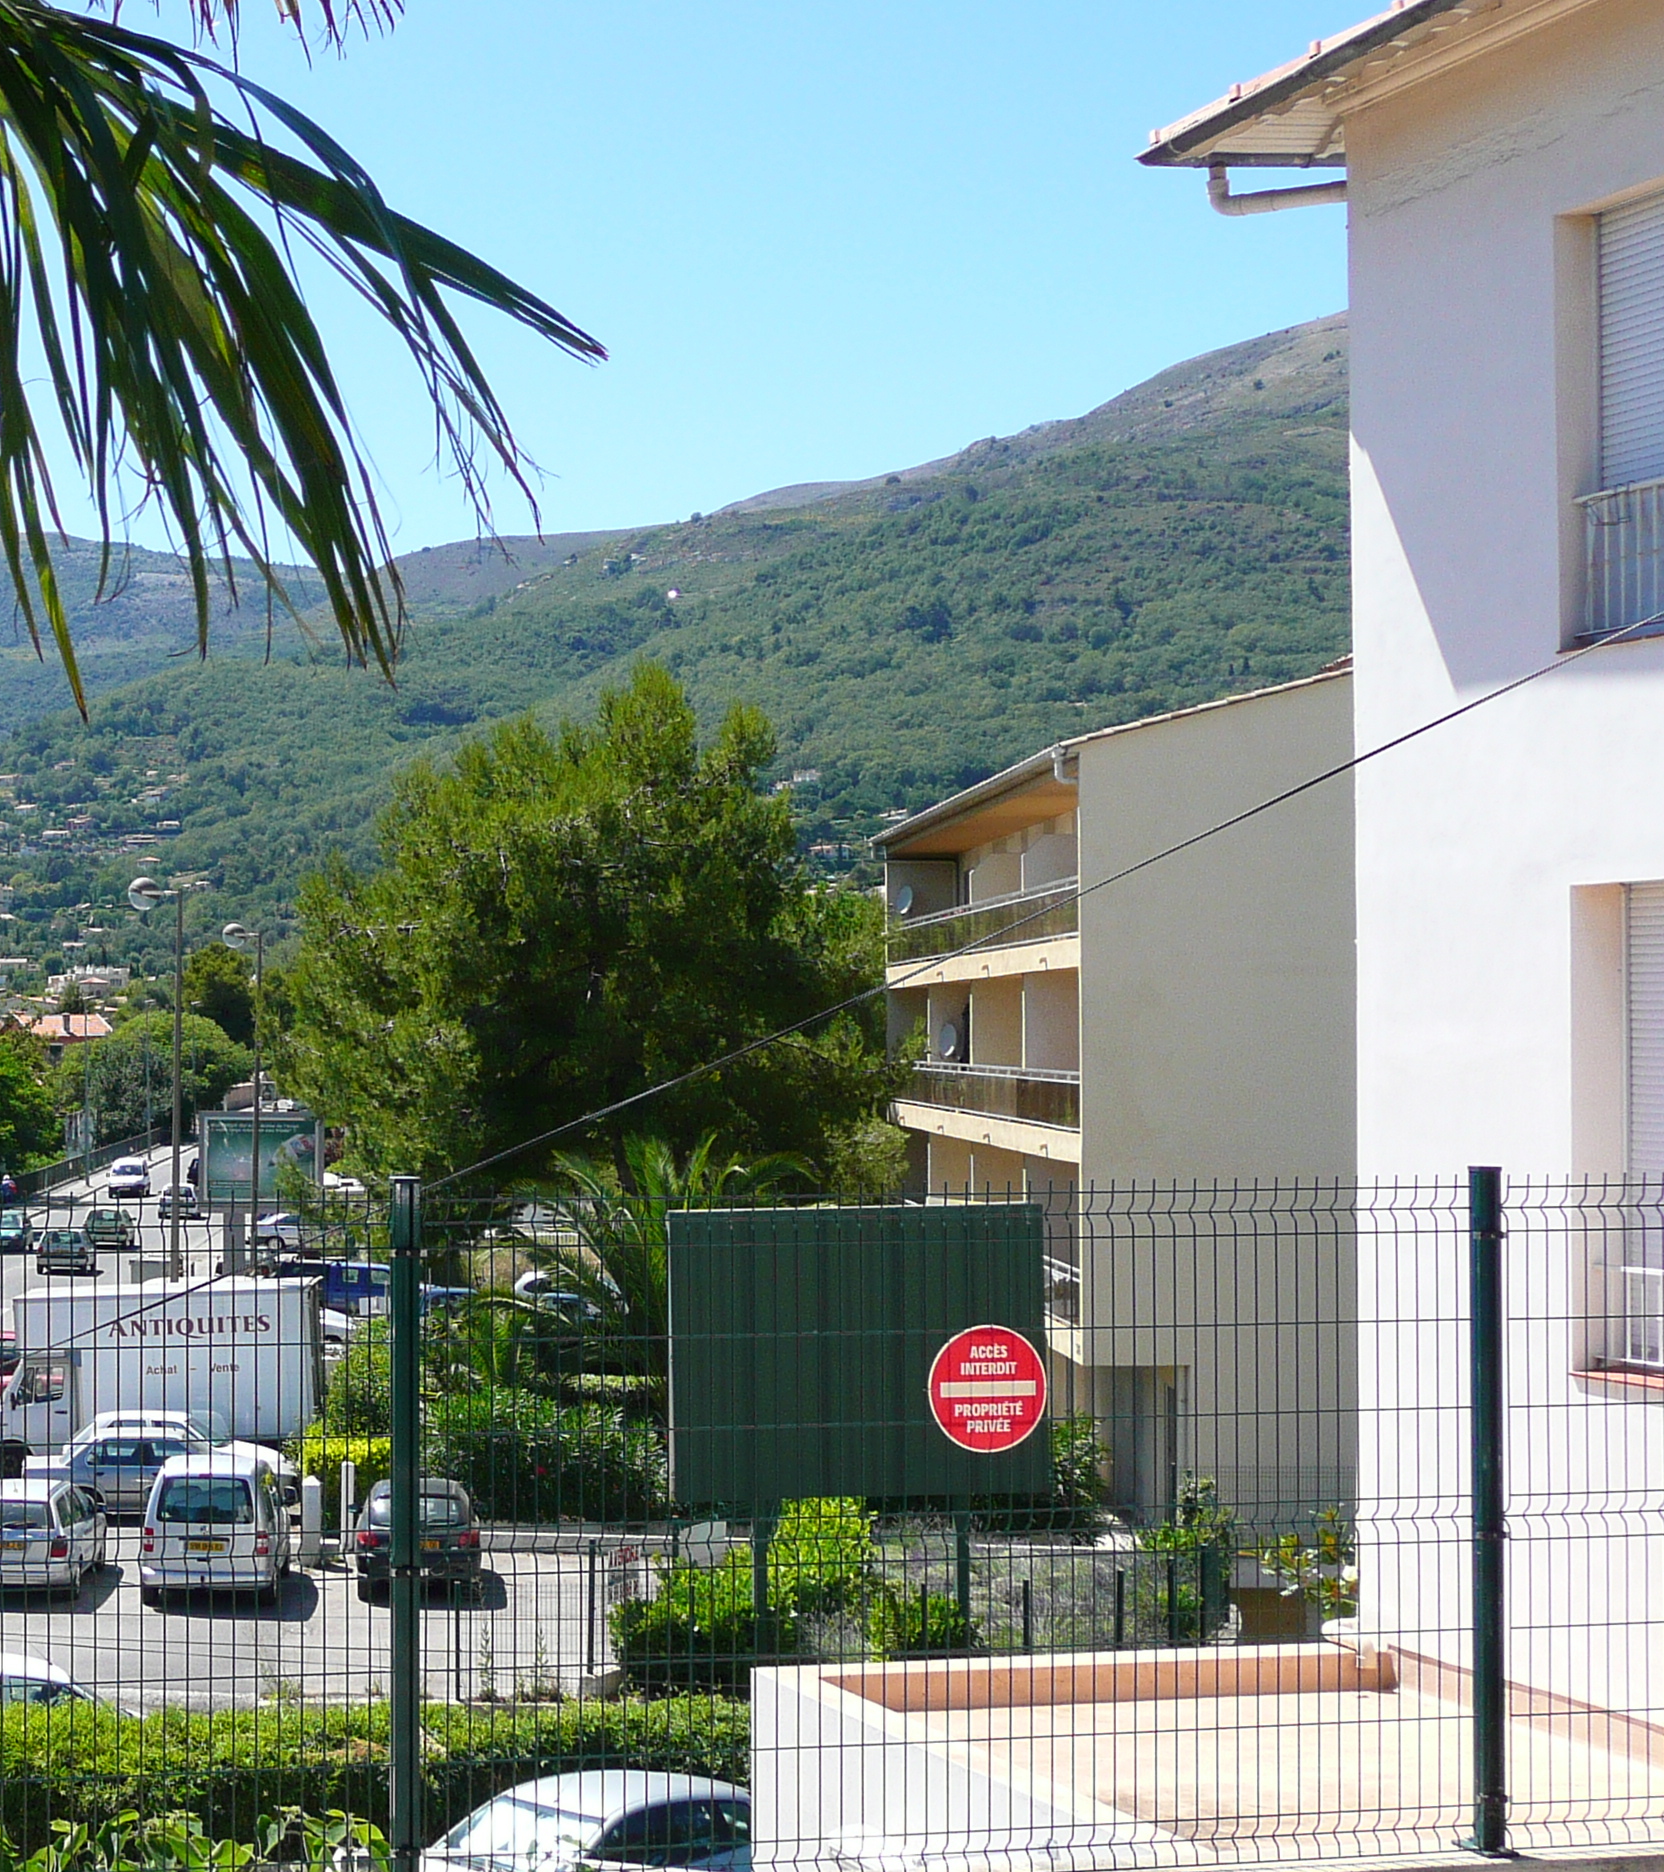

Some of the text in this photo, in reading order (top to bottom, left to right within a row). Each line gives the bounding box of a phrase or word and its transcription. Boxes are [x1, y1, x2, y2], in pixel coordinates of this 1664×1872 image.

[108, 1314, 271, 1339] ANTIQUITES
[970, 1343, 1008, 1359] ACCÈS
[146, 1364, 177, 1375] Achat
[960, 1361, 1017, 1376] INTERDIT
[954, 1400, 1023, 1417] PROPRIÉTÉ
[966, 1417, 1011, 1433] PRIVÉE
